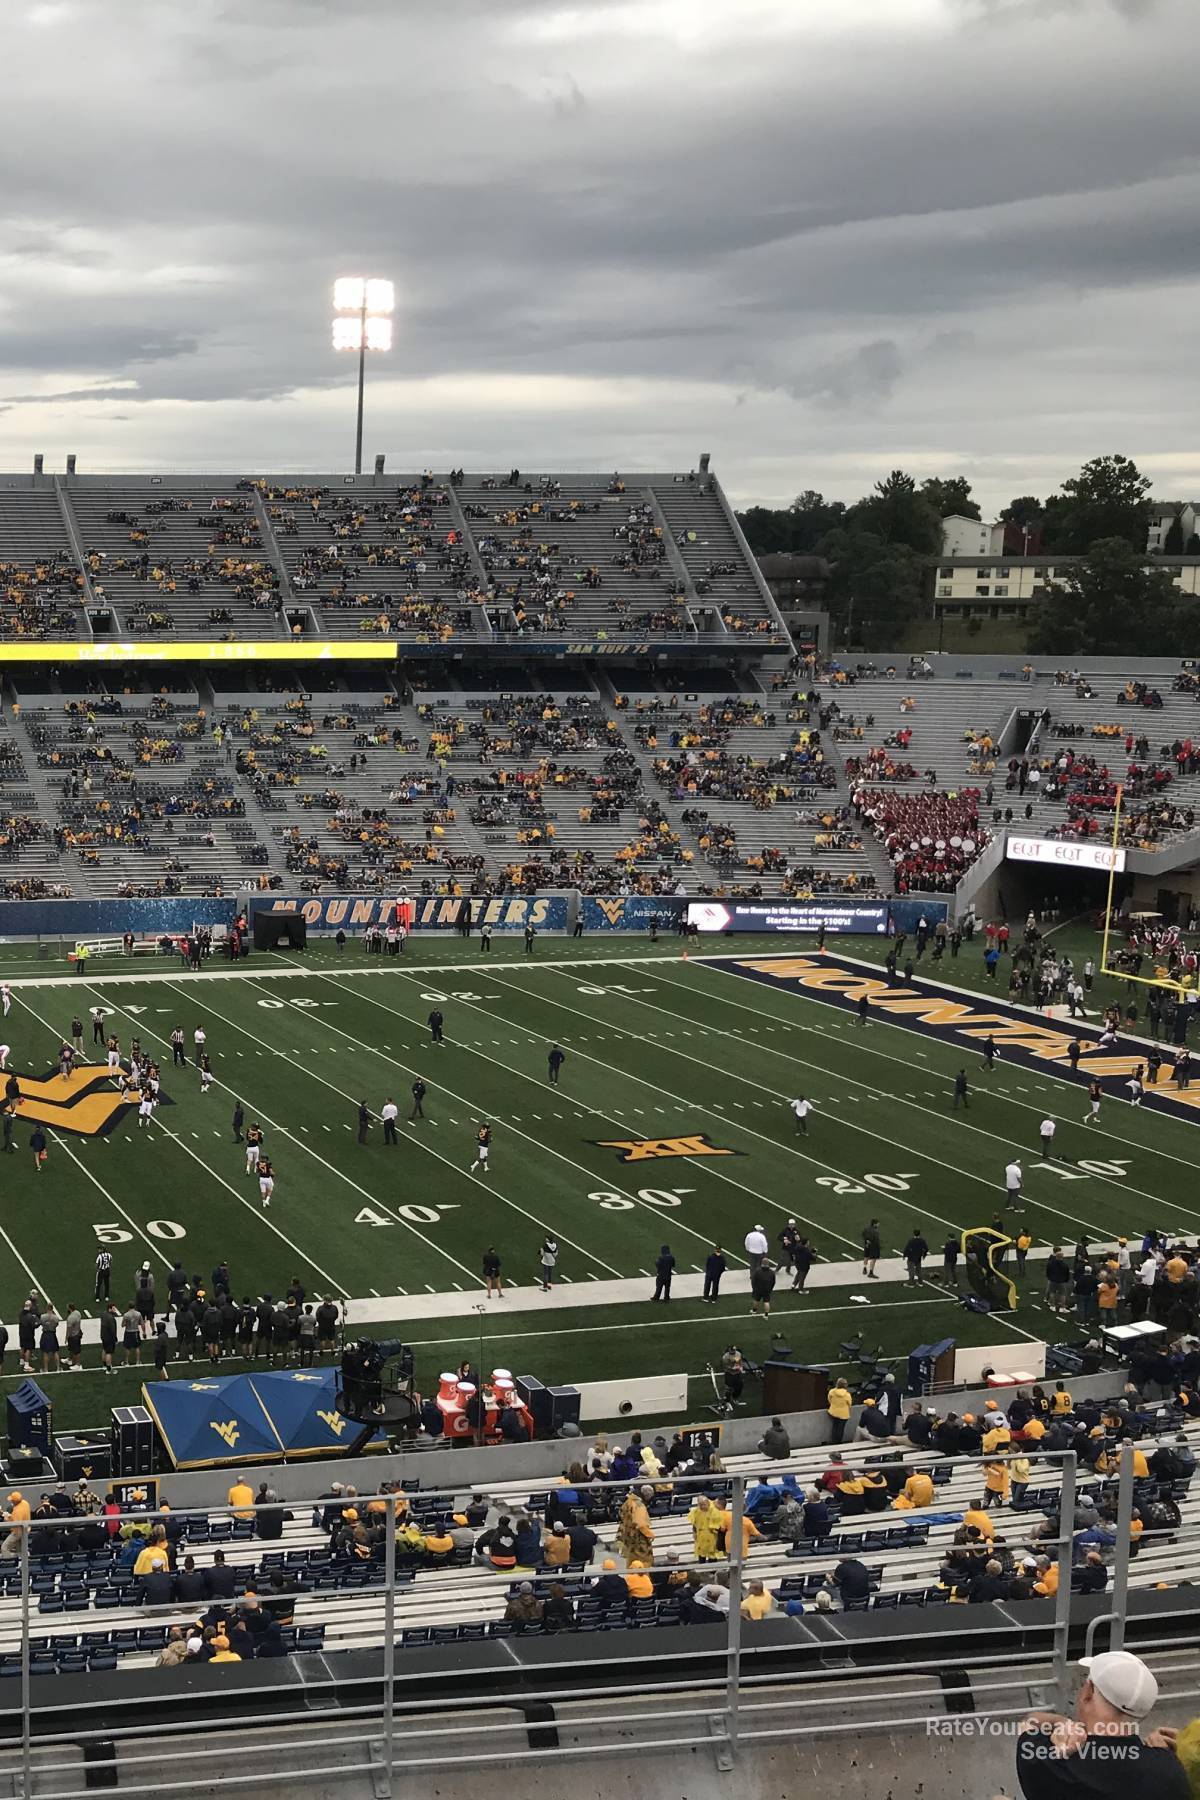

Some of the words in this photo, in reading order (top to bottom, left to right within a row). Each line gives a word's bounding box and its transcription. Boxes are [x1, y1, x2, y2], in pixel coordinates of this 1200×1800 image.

[566, 644, 592, 654] SAM
[597, 644, 628, 654] HUFF
[632, 644, 649, 654] 75
[1013, 842, 1043, 857] EQT
[1054, 846, 1083, 861] EQT
[1094, 851, 1119, 866] EQT
[766, 917, 798, 926] Starting
[809, 917, 824, 925] the
[1041, 1399, 1048, 1410] 8
[1063, 1395, 1070, 1406] 8
[121, 1485, 148, 1502] 125
[217, 1620, 226, 1636] 5
